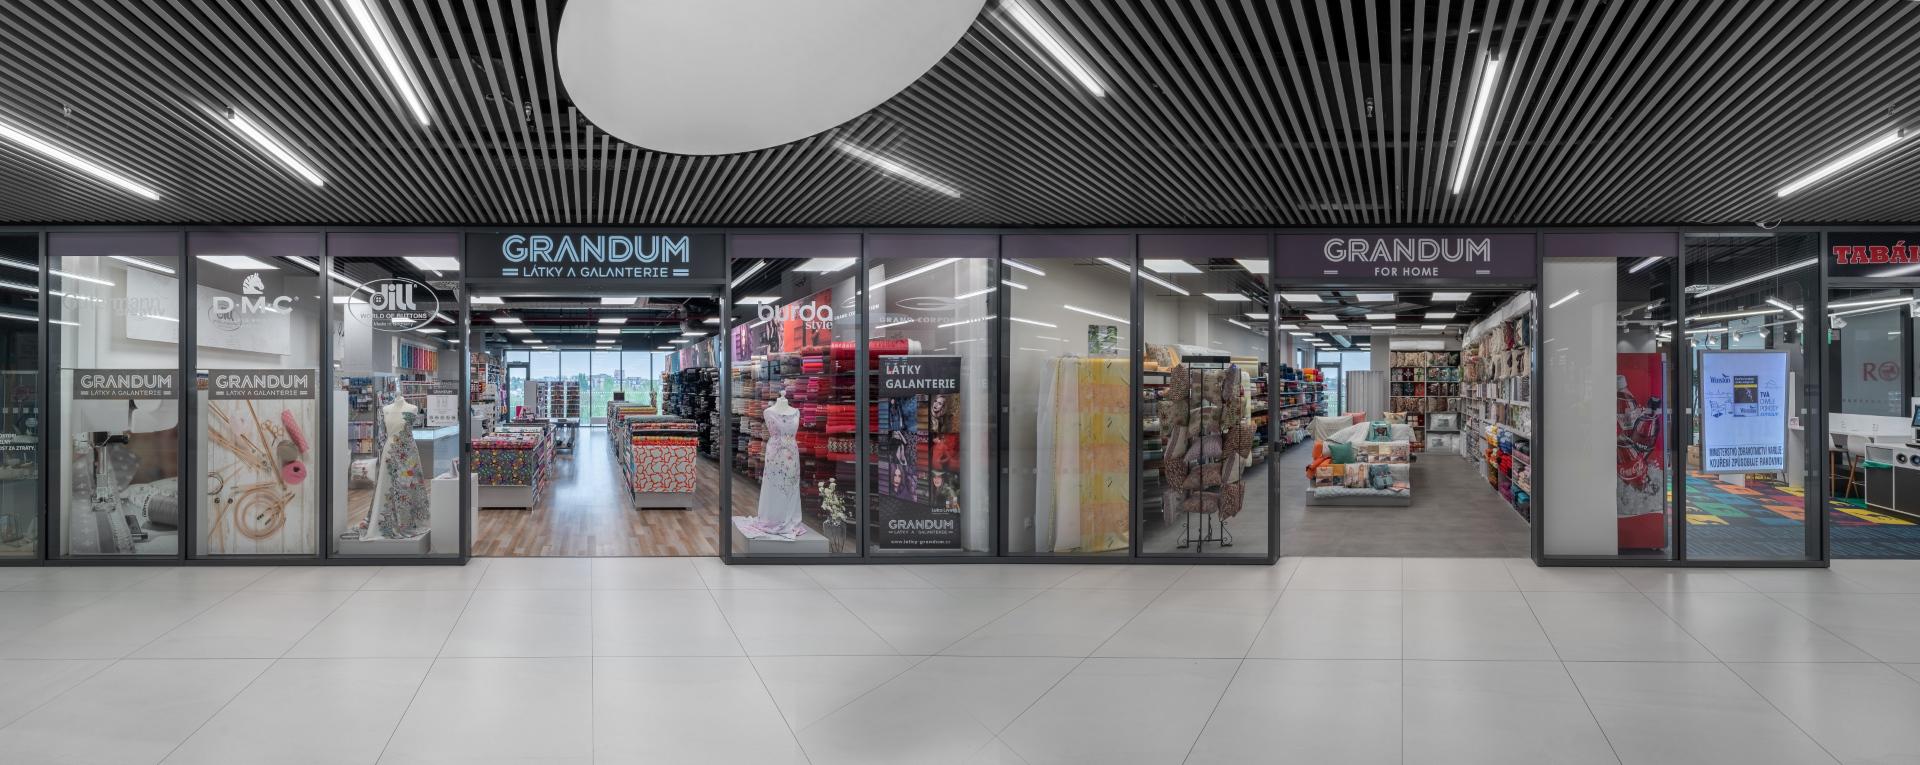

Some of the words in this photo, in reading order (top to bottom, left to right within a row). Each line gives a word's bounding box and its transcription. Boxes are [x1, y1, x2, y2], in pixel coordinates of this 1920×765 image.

[502, 235, 690, 263] GRANDUM
[1323, 238, 1491, 262] GRANDUM
[523, 265, 563, 277] LÁTKY
[566, 267, 576, 277] A
[580, 267, 669, 278] GALANTERIE
[1374, 267, 1398, 276] FOR
[1402, 267, 1439, 276] HOME
[370, 284, 416, 310] dill
[757, 301, 833, 321] burda
[805, 320, 833, 332] style
[80, 375, 172, 388] GRANDUM
[215, 375, 308, 388] GRANDUM
[885, 379, 956, 389] GALANTERIE
[888, 520, 954, 529] GRANDUM
